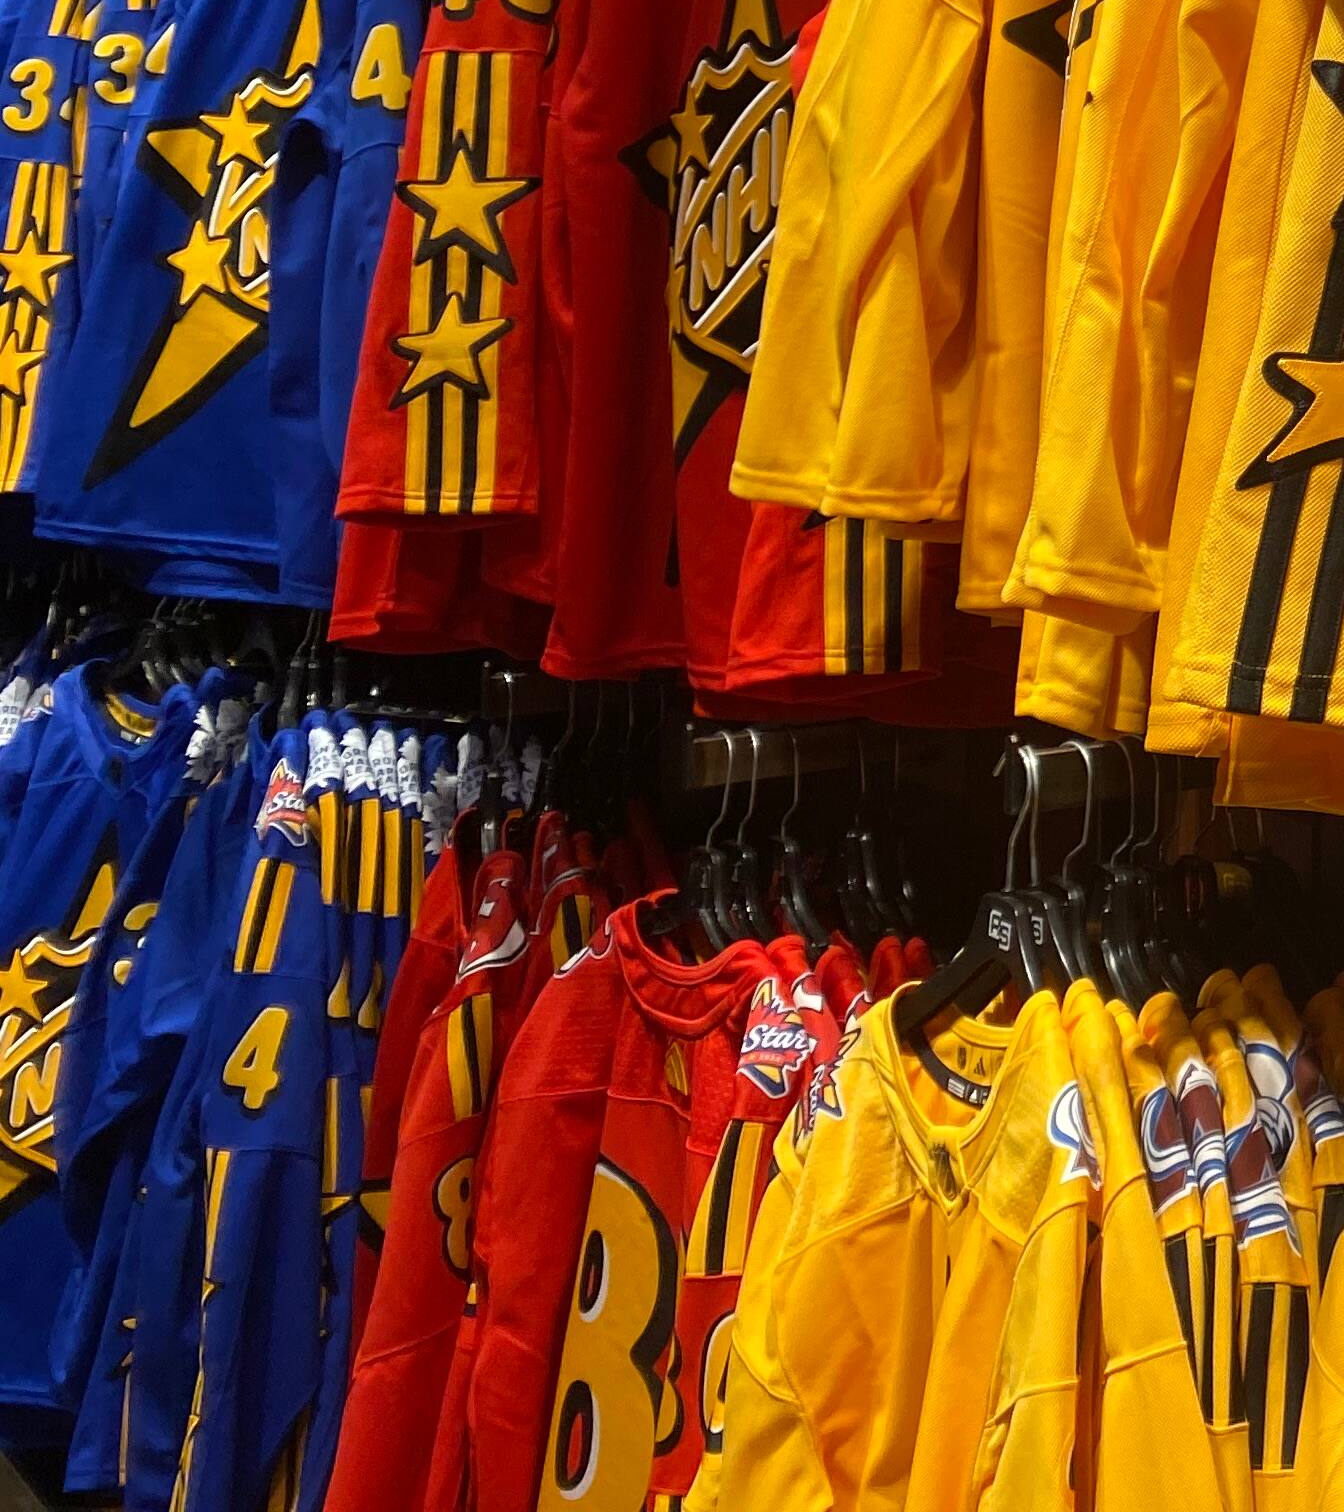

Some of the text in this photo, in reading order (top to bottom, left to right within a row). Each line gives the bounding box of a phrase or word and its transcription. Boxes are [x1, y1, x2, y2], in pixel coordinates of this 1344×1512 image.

[350, 23, 412, 112] 4
[267, 791, 305, 813] Sta
[222, 1006, 290, 1114] 4
[741, 1024, 811, 1053] Star
